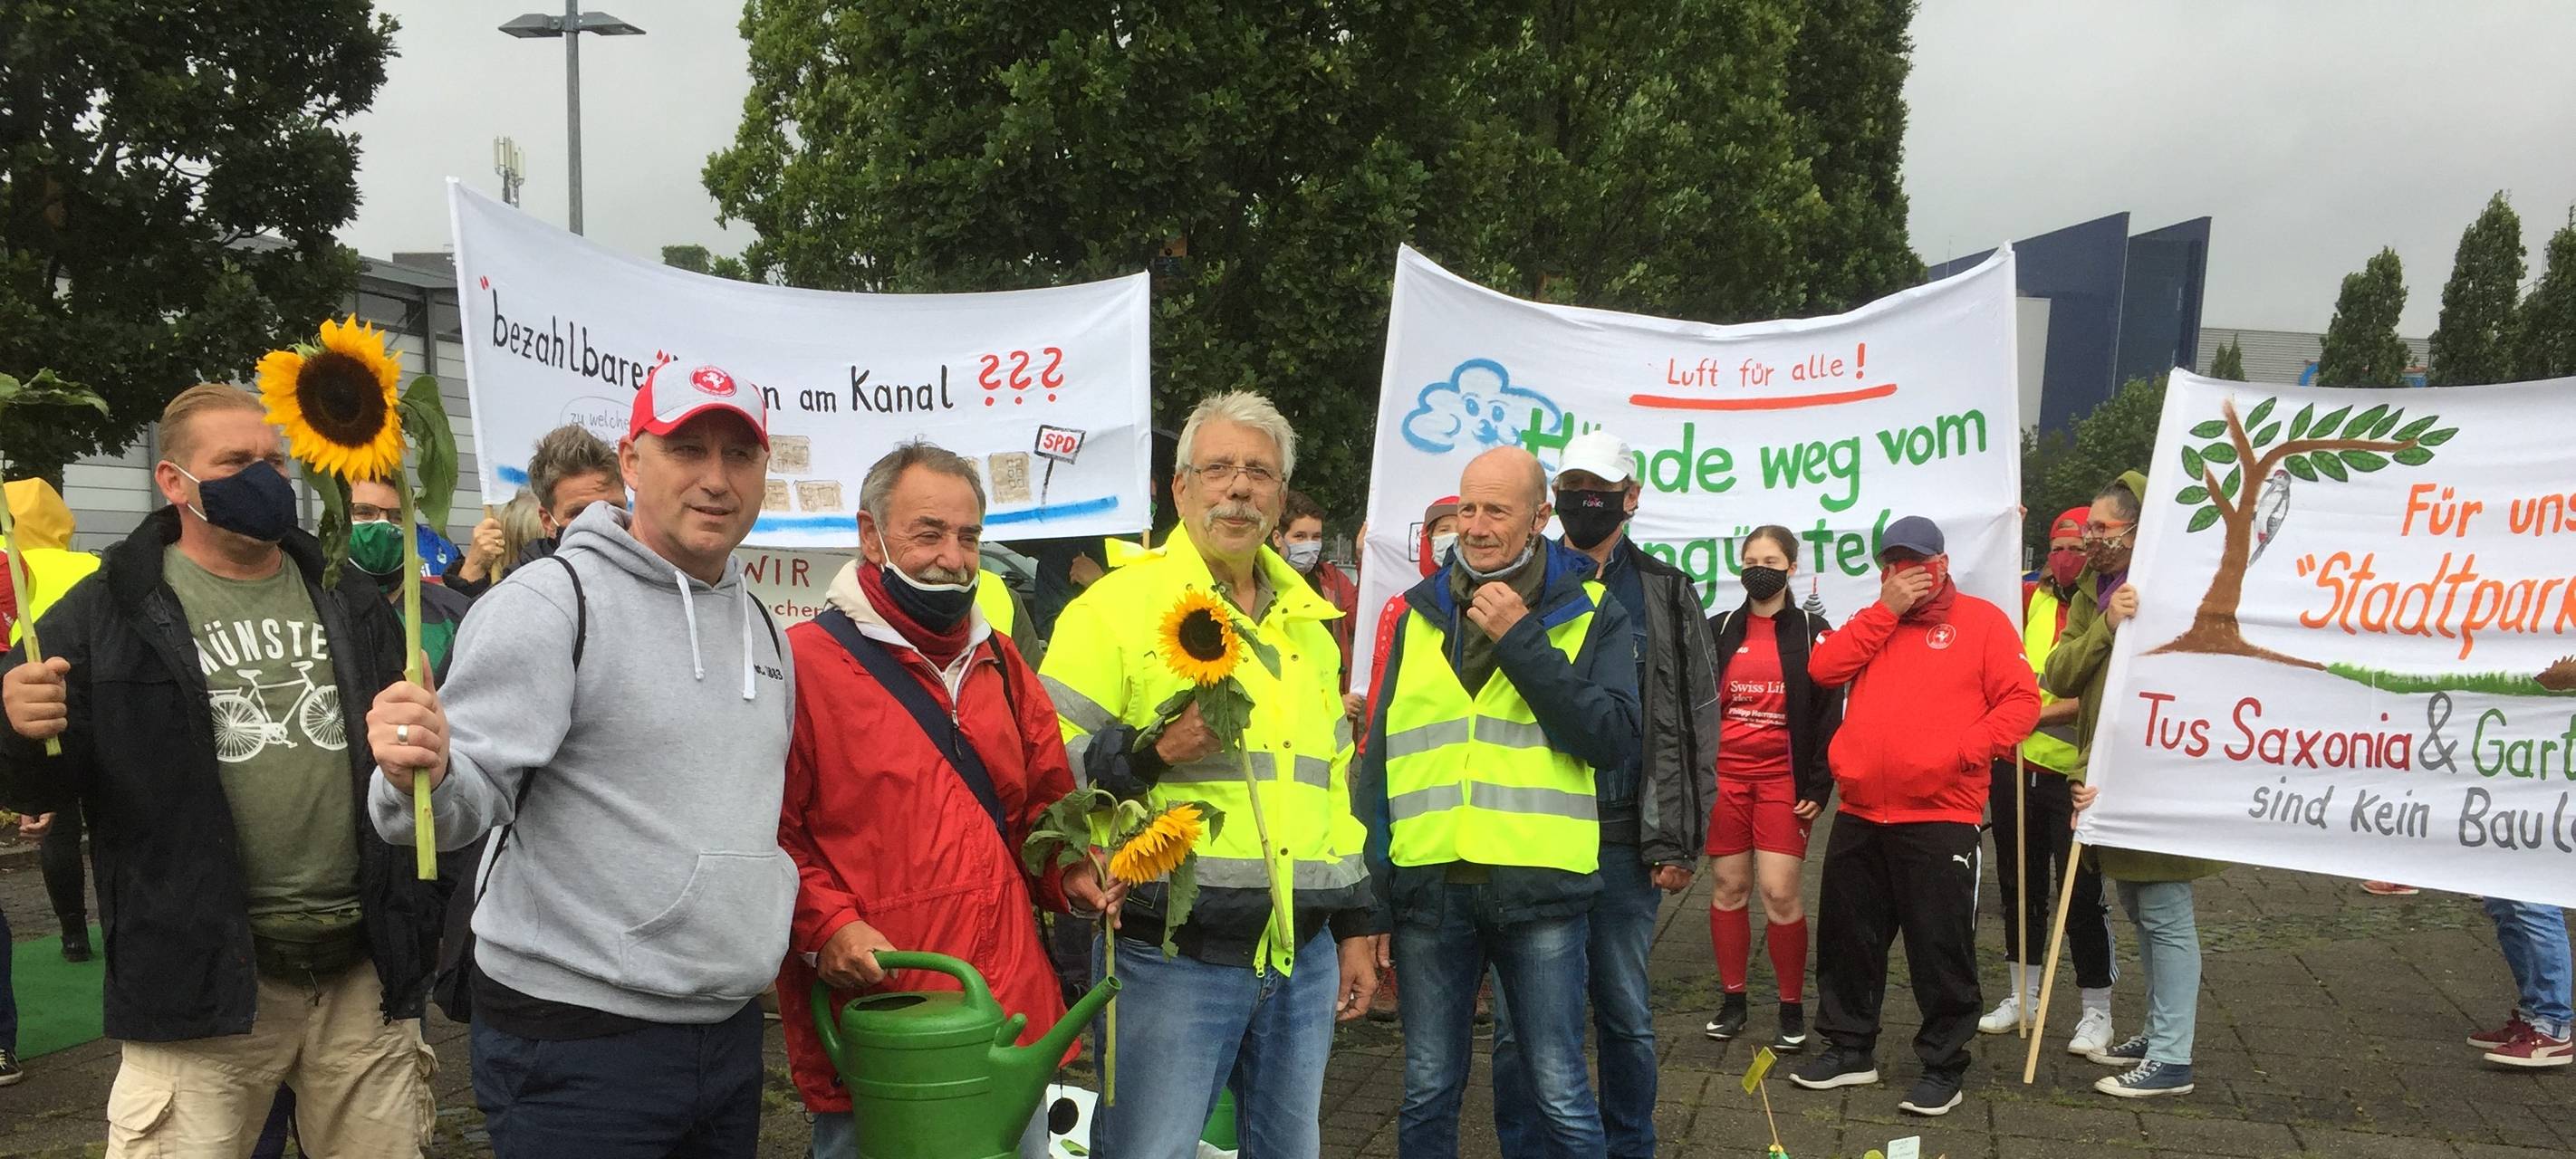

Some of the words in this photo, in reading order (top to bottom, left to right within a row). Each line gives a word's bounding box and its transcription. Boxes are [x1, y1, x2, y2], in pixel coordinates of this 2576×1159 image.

[800, 388, 836, 412] am
[851, 365, 954, 413] Kanal
[979, 347, 1063, 406] ???
[1668, 359, 1718, 388] Luft
[1740, 359, 1774, 388] für
[571, 413, 584, 426] zu
[1043, 433, 1075, 454] SPD
[1522, 407, 1736, 493] Hde
[1760, 436, 1860, 512] weg
[1876, 408, 1987, 465] vom
[2401, 483, 2483, 538] Für
[192, 618, 328, 676] ÜNSTE
[1730, 680, 1764, 694] Swiss
[1767, 681, 1785, 694] Lif
[2139, 691, 2210, 758] Tus
[2224, 696, 2413, 771] Saxonia
[2418, 692, 2458, 774] &
[2248, 776, 2335, 830] sind
[2458, 786, 2576, 854] Baul
